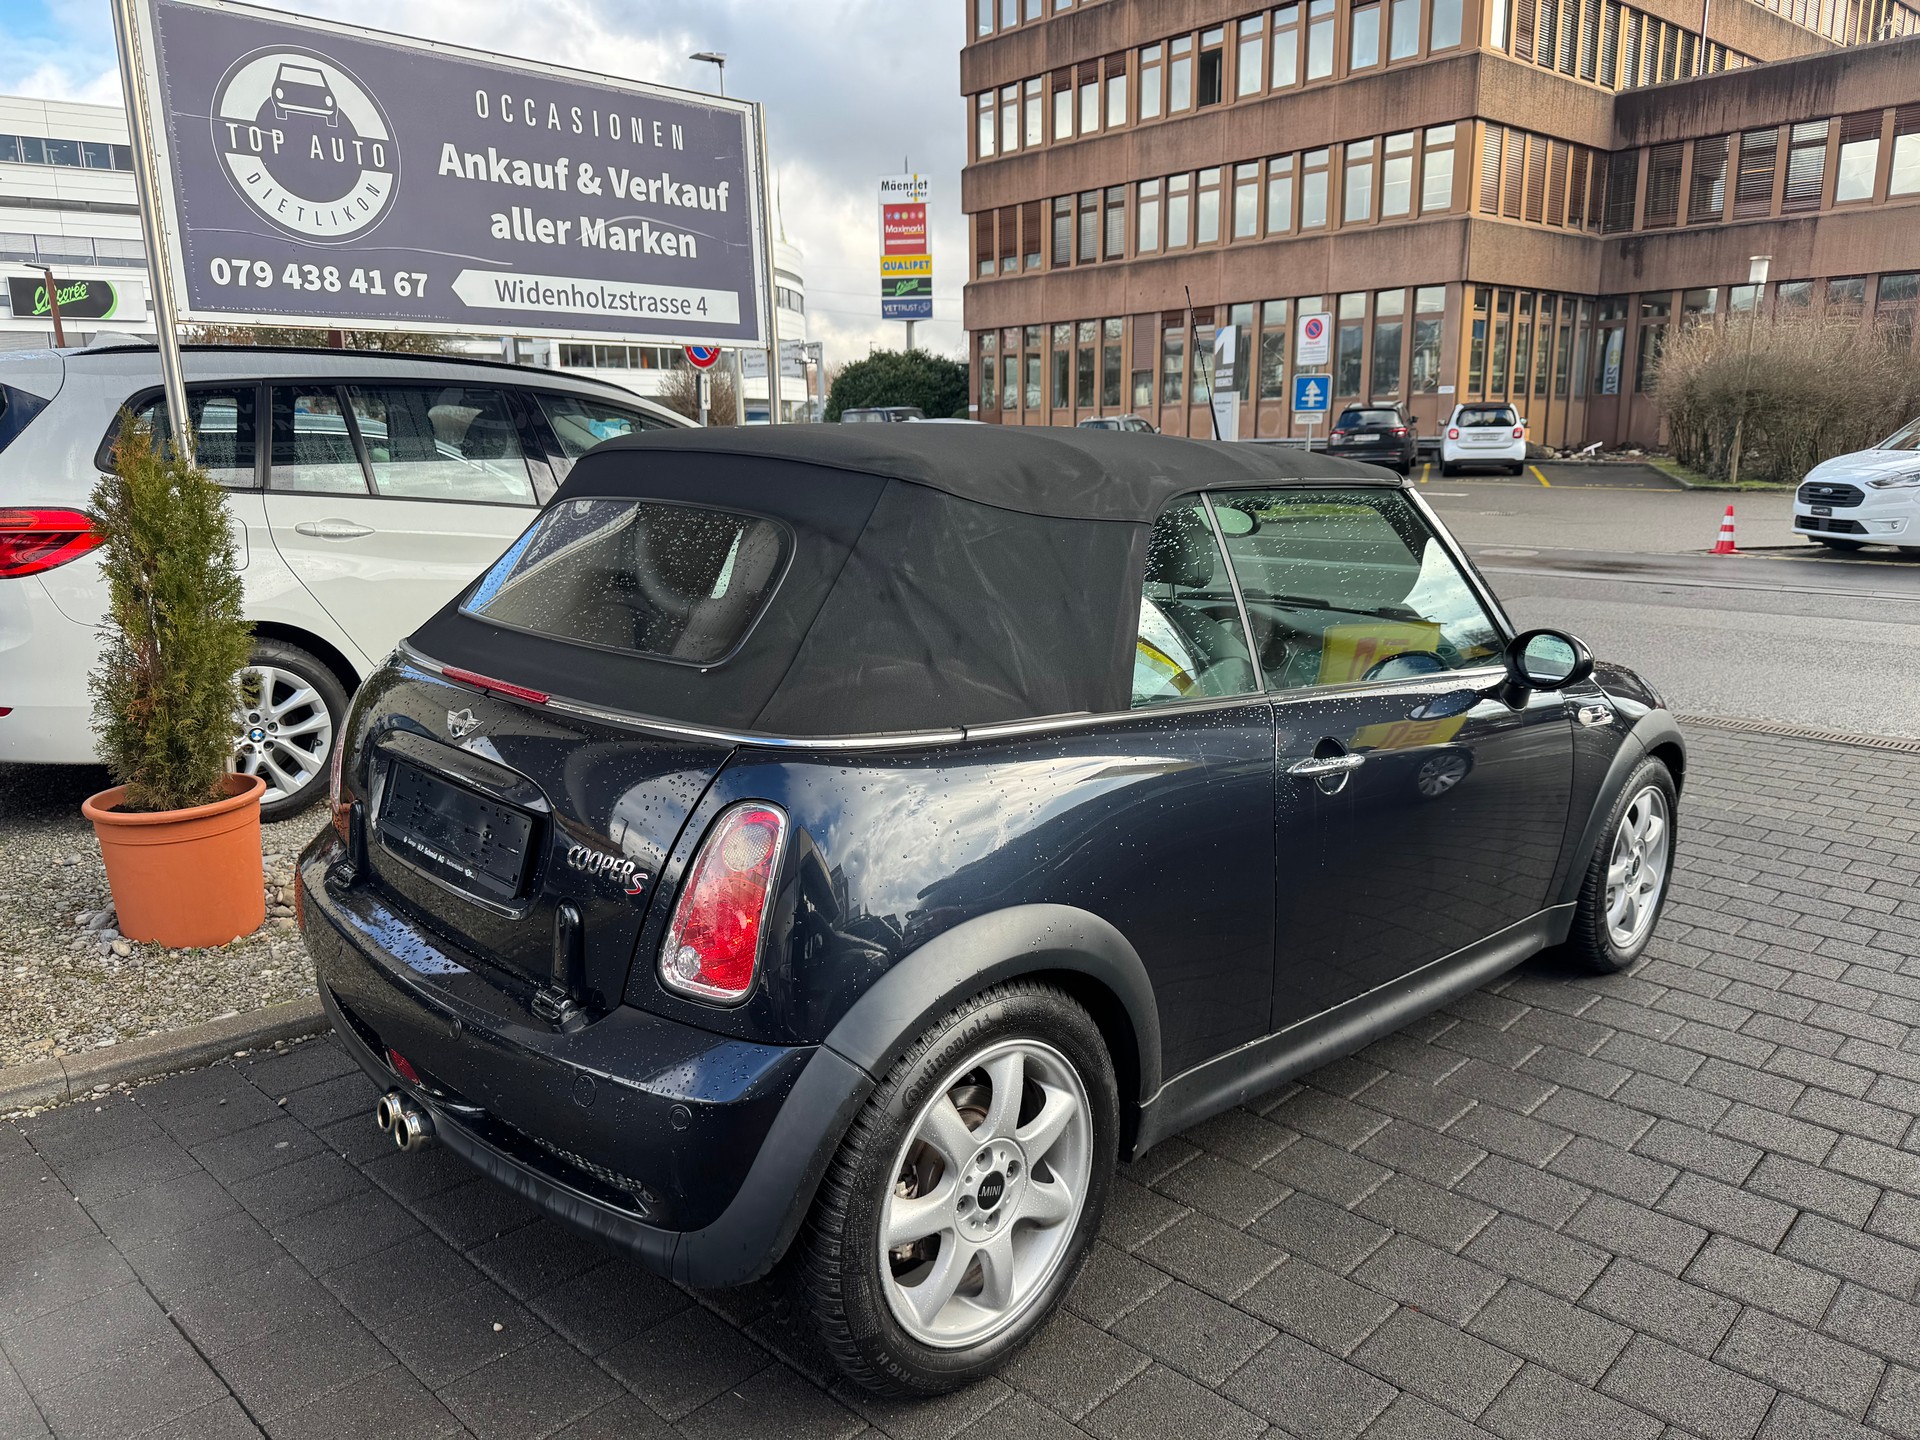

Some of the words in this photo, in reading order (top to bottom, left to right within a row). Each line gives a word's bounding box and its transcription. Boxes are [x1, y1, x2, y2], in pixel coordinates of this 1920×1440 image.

[475, 89, 684, 151] OCCASIONEN
[225, 122, 285, 154] TOP
[310, 134, 386, 168] AUTO
[246, 171, 381, 227] DIETLIKON
[438, 142, 569, 193] Ankauf
[576, 162, 603, 197] &
[607, 166, 729, 213] Verkauf
[490, 206, 572, 246] aller
[579, 215, 697, 259] Marken
[210, 257, 274, 289] 079
[282, 263, 342, 293] 438
[349, 268, 387, 295] 41
[393, 271, 428, 298] 67
[882, 260, 930, 271] QUALIPET
[494, 278, 692, 316] Widenholzstrasse
[696, 296, 708, 316] 4
[567, 845, 636, 884] COOPER
[623, 873, 648, 894] S
[981, 1185, 1001, 1197] MINI
